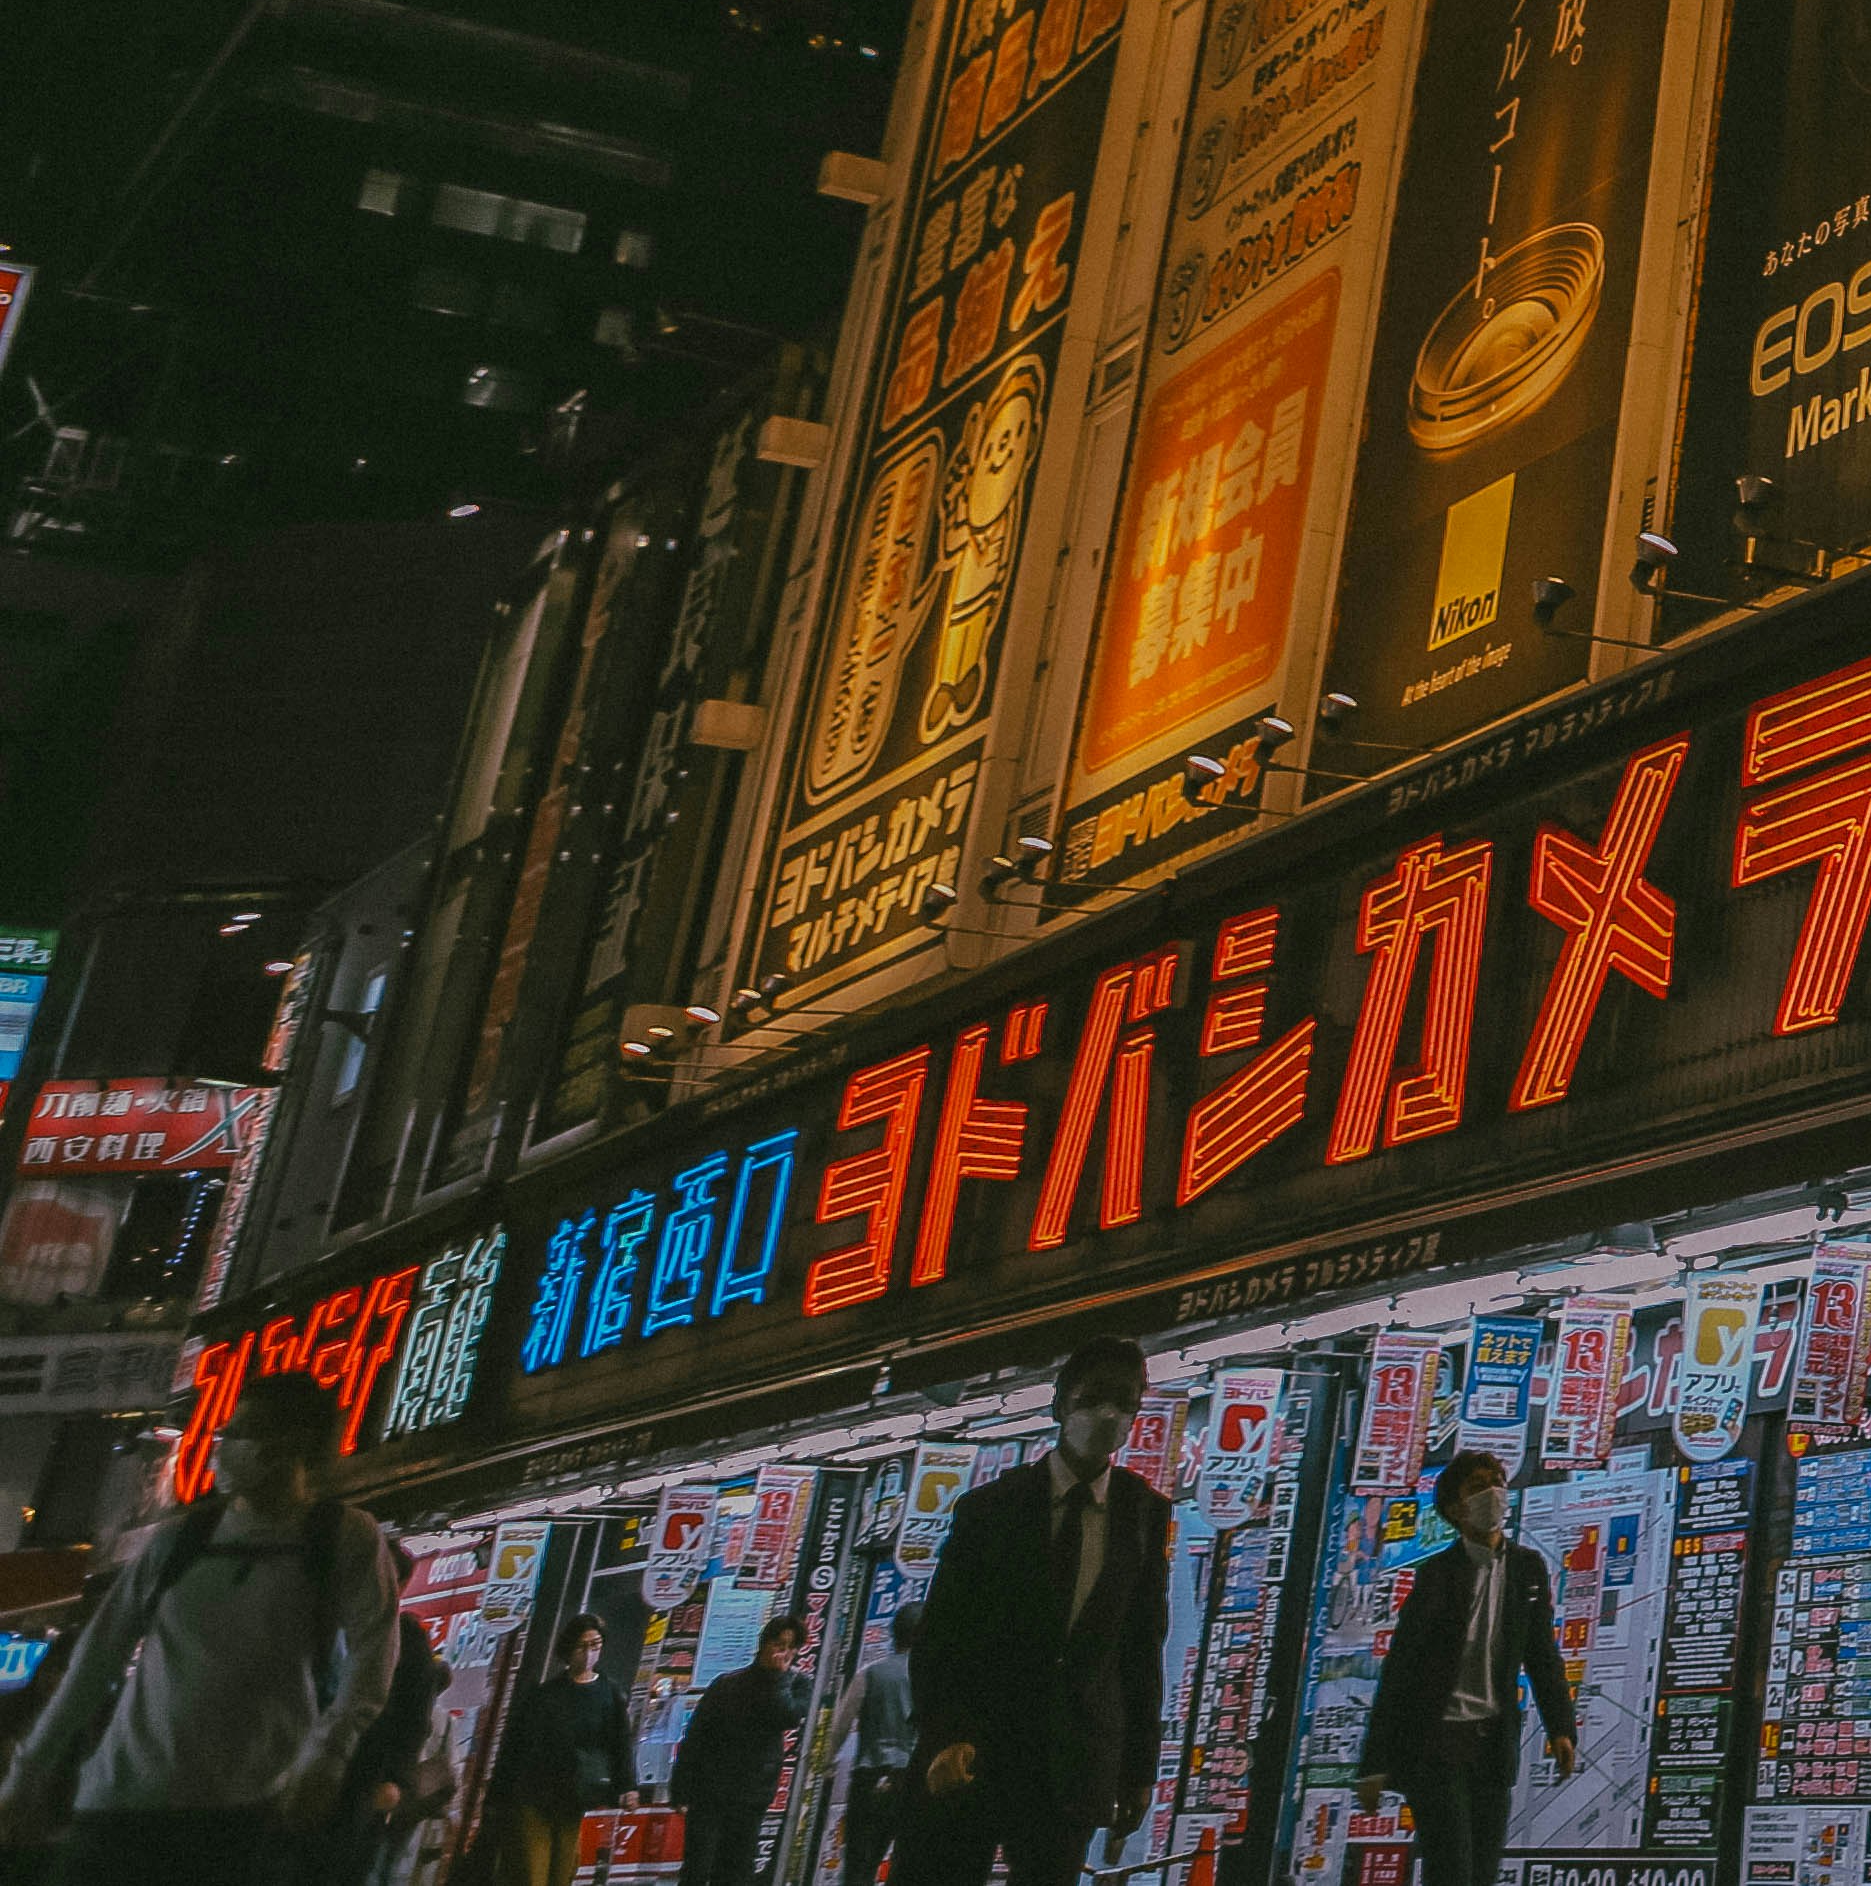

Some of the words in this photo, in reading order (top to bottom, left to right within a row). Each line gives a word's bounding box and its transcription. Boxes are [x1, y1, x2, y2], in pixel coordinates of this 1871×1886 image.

[1130, 385, 1310, 582] 新規会員
[1127, 527, 1267, 690] 募集中
[1431, 589, 1498, 644] Nikon
[771, 759, 980, 932] ヨドバシカメラ
[519, 1128, 801, 1374] 新宿西口
[1176, 1264, 1296, 1322] ヨドバシカメラ
[1811, 1279, 1860, 1329] 13
[1561, 1328, 1607, 1375] 13
[1374, 1364, 1418, 1407] 13
